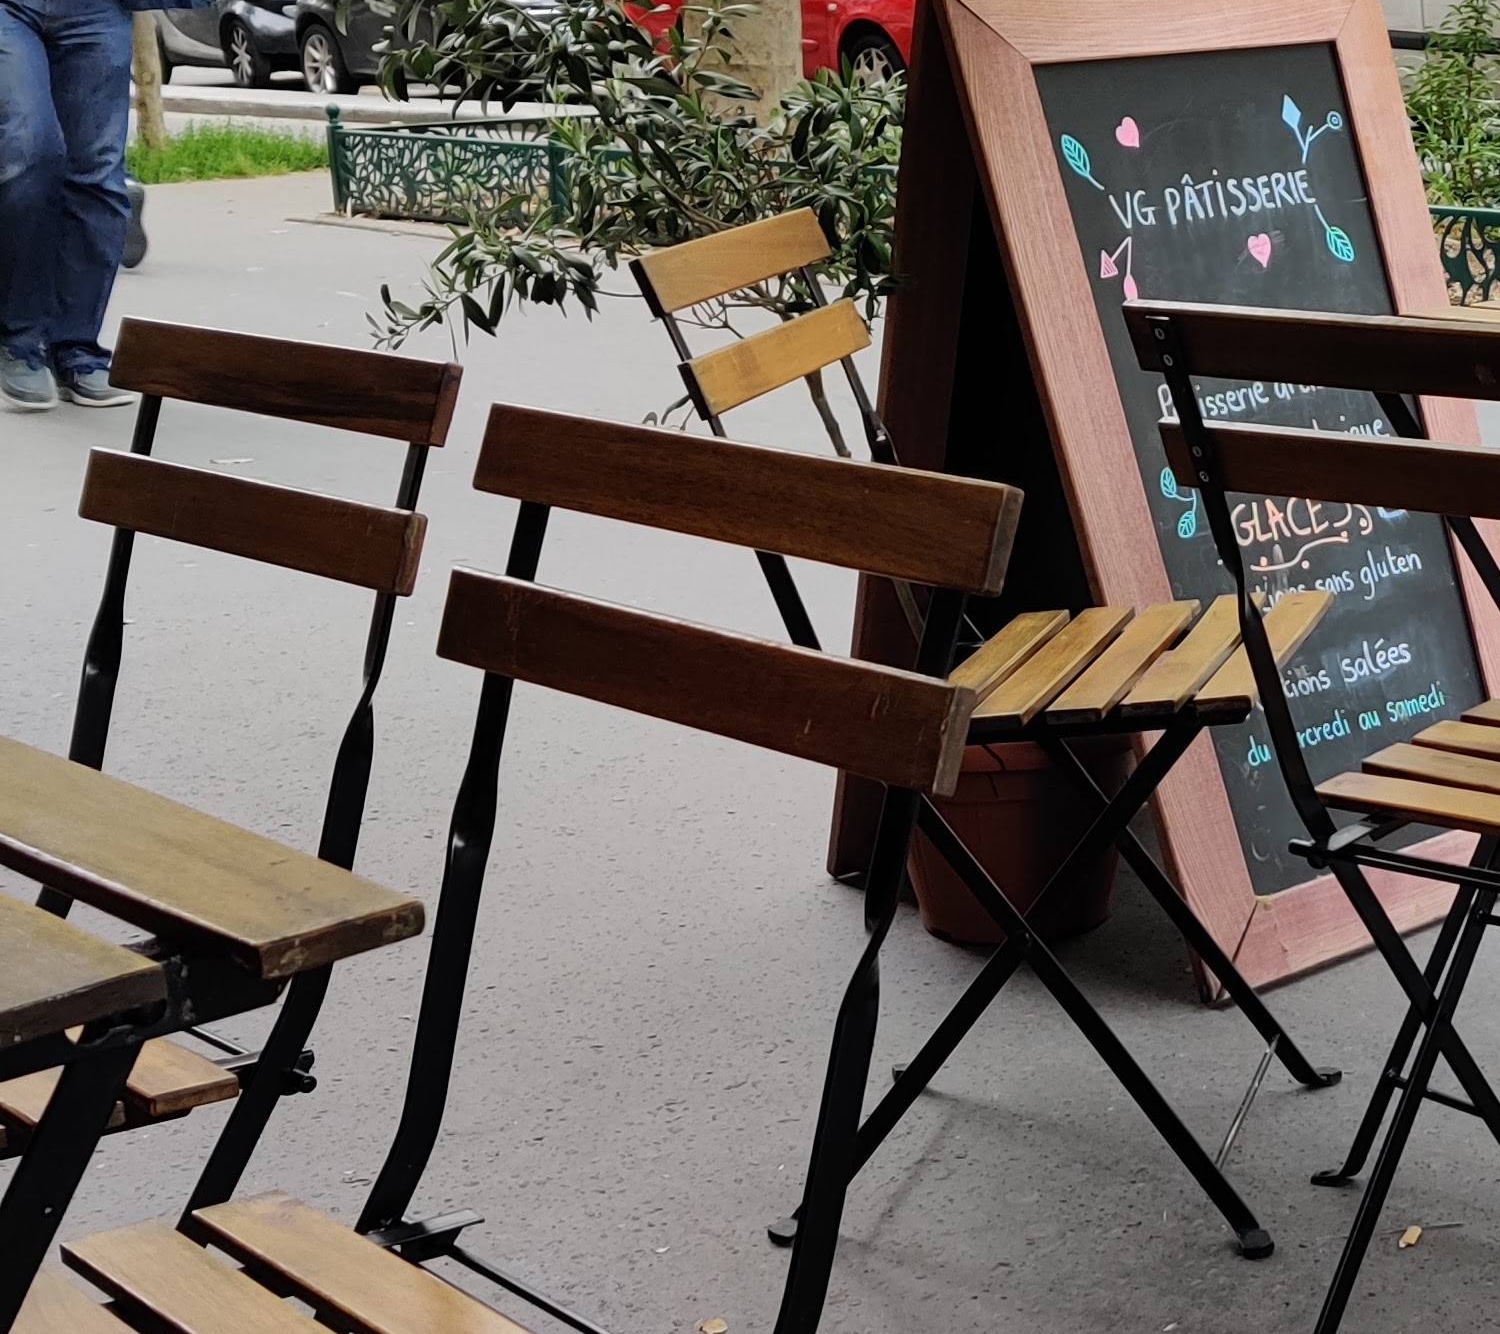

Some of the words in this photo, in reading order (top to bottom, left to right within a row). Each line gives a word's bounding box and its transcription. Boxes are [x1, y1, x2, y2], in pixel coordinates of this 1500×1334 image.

[1108, 190, 1157, 230] VG
[1359, 545, 1423, 602] gluten
[1341, 637, 1412, 684] salées
[1297, 708, 1351, 749] rcredi
[1358, 709, 1381, 732] au
[1385, 680, 1446, 723] samedi
